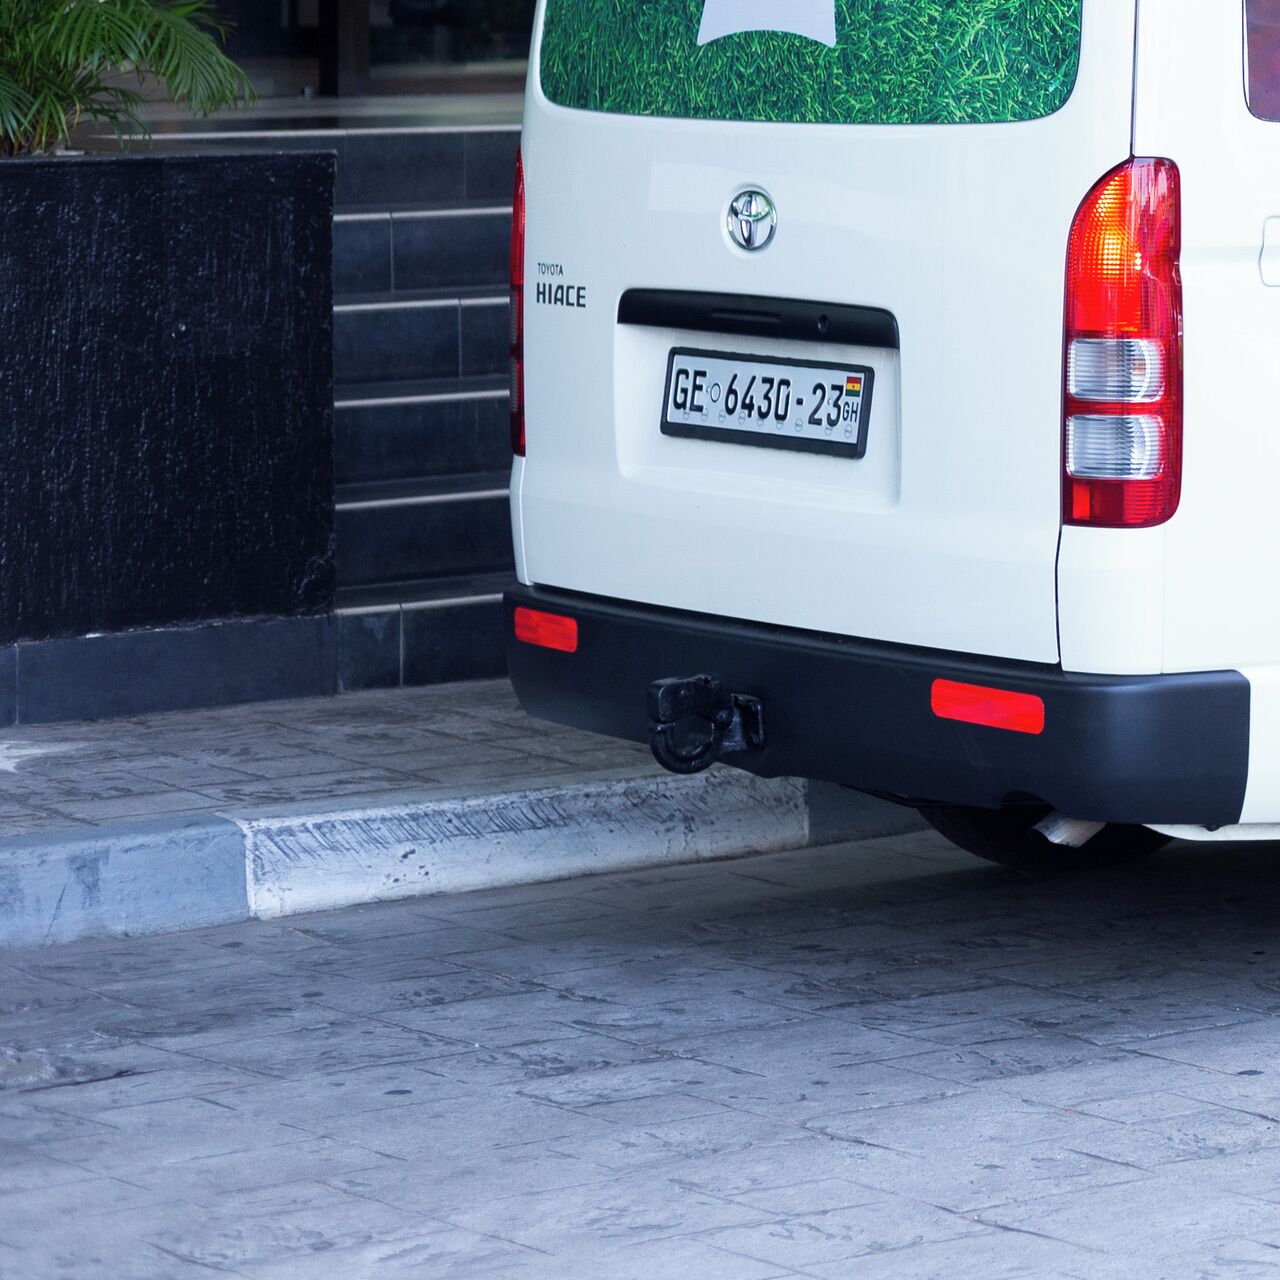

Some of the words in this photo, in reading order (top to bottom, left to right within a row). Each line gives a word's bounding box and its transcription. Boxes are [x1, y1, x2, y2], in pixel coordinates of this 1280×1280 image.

[537, 262, 564, 276] TOYOTA
[536, 282, 586, 308] HIACE
[673, 368, 707, 413] GE
[842, 401, 859, 423] GH
